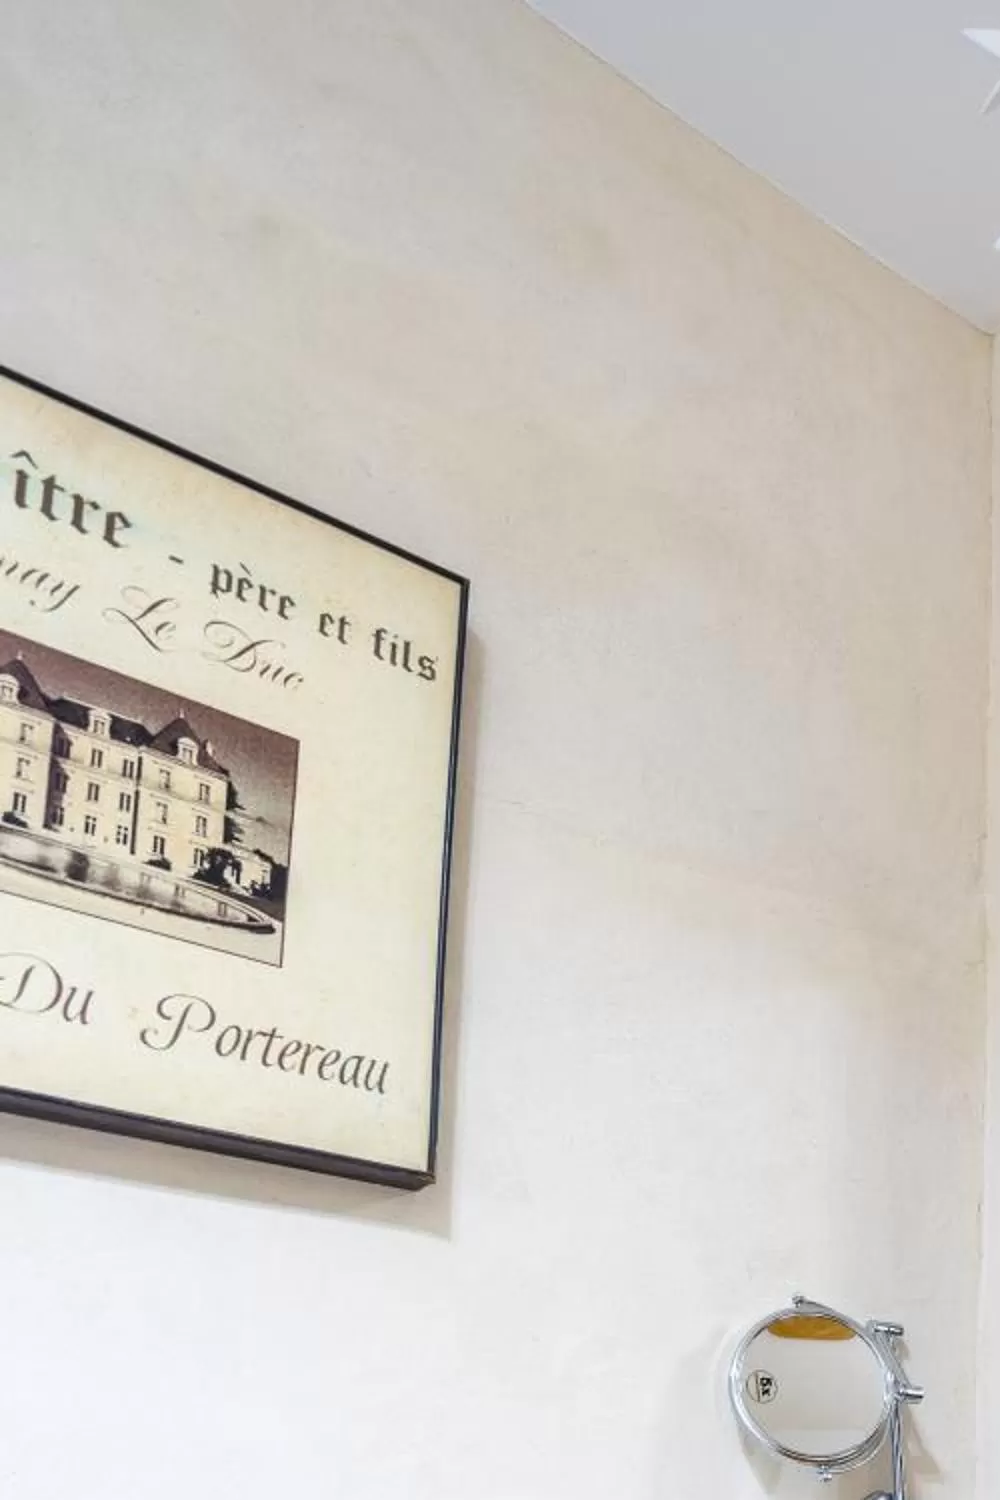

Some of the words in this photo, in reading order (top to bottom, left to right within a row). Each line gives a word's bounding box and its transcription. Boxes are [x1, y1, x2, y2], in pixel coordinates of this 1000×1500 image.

[101, 585, 181, 653] Le
[210, 561, 298, 621] père
[317, 610, 353, 646] et
[371, 625, 438, 682] fils
[0, 951, 95, 1026] Du
[139, 993, 391, 1096] Portereau
